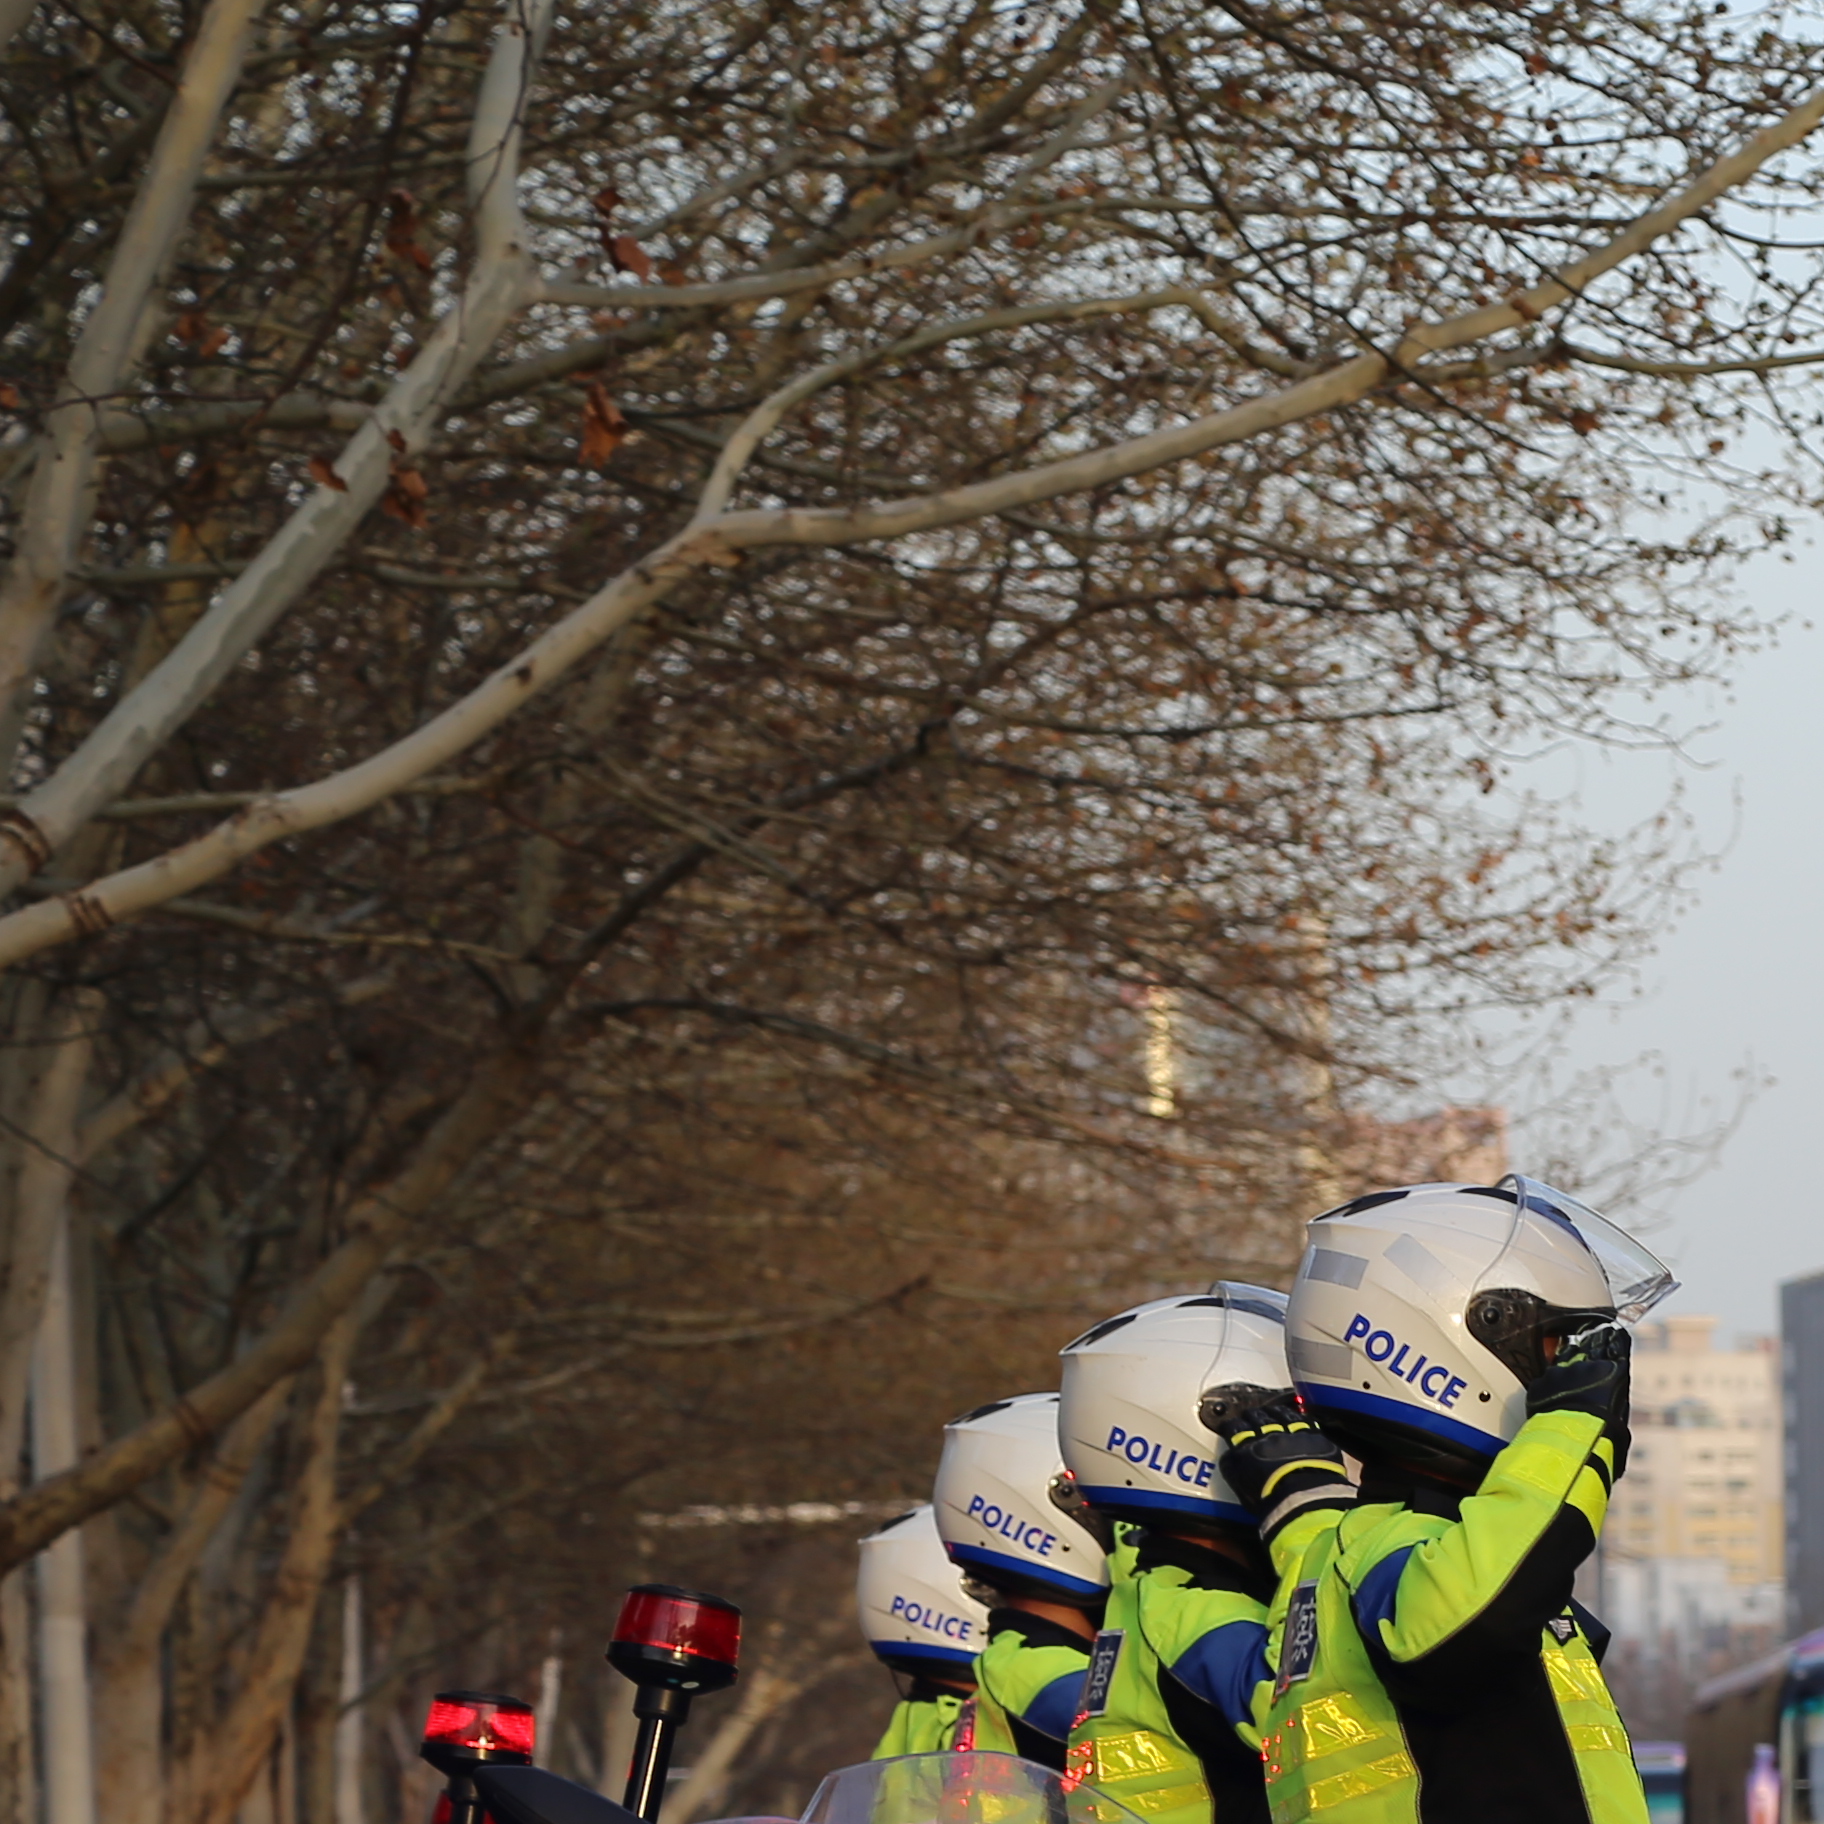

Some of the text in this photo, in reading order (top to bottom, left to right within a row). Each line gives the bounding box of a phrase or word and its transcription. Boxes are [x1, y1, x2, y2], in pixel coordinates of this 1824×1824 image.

[1343, 1313, 1468, 1409] POLICE
[1107, 1426, 1215, 1487] POLICE
[967, 1494, 1057, 1556] POLICE
[891, 1595, 973, 1640] POLICE
